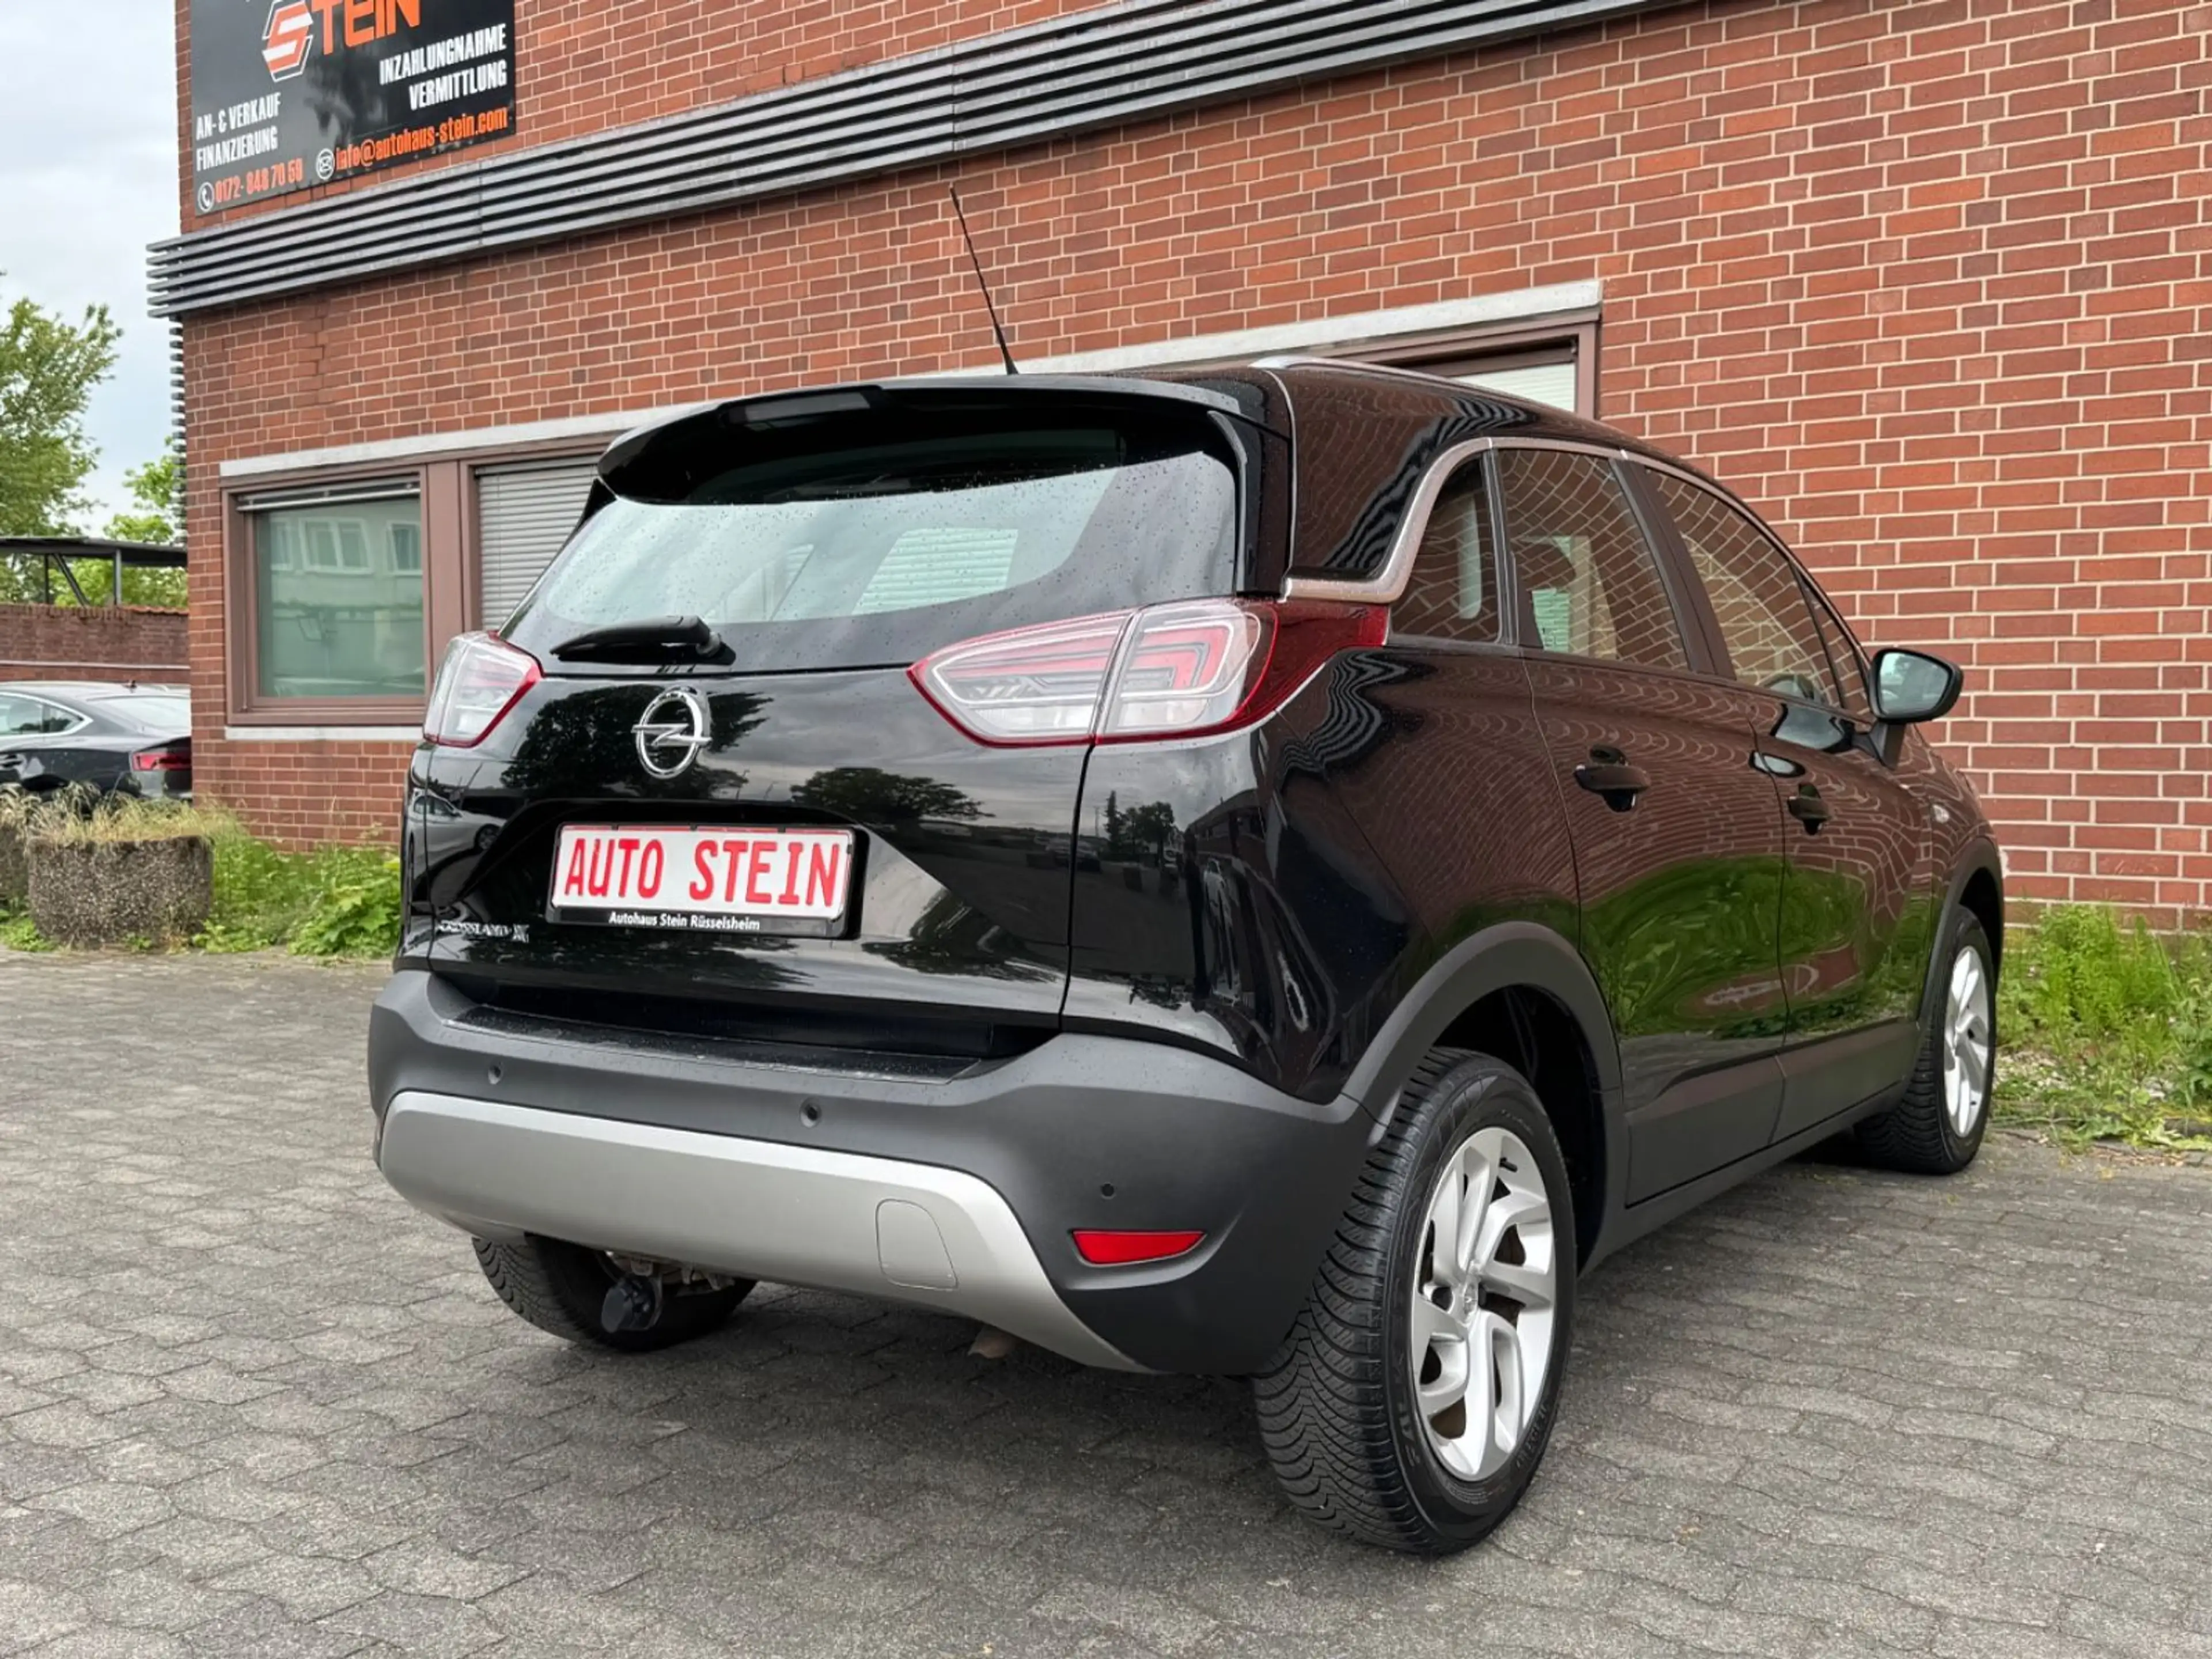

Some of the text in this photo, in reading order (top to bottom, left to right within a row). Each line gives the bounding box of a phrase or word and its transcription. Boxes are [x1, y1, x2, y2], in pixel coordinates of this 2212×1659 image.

[379, 22, 507, 86] INZAHLUNGNAHME
[408, 59, 507, 111] VERMITTLUNG
[196, 92, 281, 141] AN- & VERKAUF
[336, 107, 508, 170] info@autohaus-stein.com
[196, 125, 278, 172] FINANZIERUNG
[564, 838, 840, 908] AUTO STEIN
[608, 911, 760, 931] Autohaus Stein Rüsselsheim
